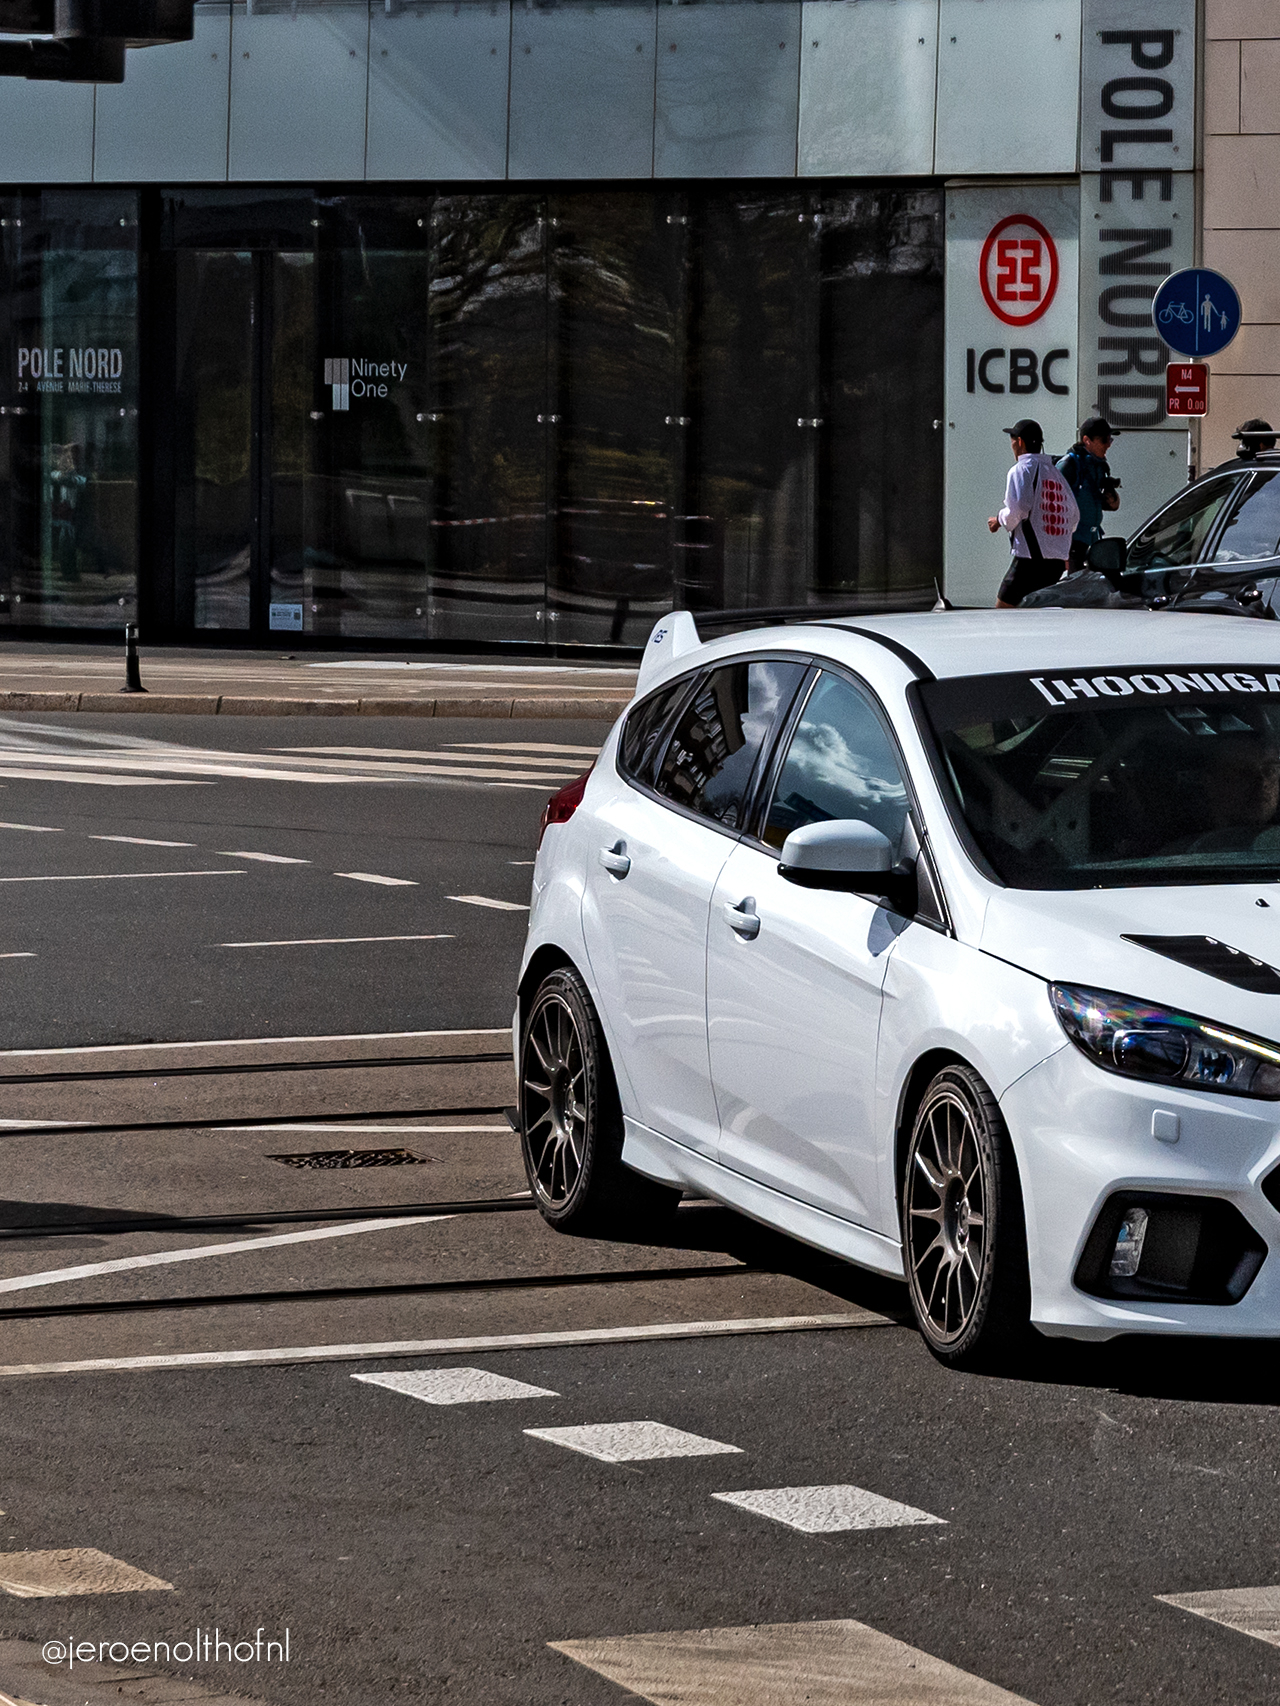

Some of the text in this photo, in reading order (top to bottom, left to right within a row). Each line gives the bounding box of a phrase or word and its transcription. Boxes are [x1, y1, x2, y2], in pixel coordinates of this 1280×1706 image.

[1097, 29, 1174, 427] POLE NORD
[18, 347, 123, 379] POLE NORD
[351, 357, 408, 382] Ninety
[966, 347, 1070, 396] ICBC
[1181, 368, 1193, 381] N4
[36, 381, 64, 393] AVENUE
[351, 378, 388, 398] One
[1169, 398, 1180, 410] PR
